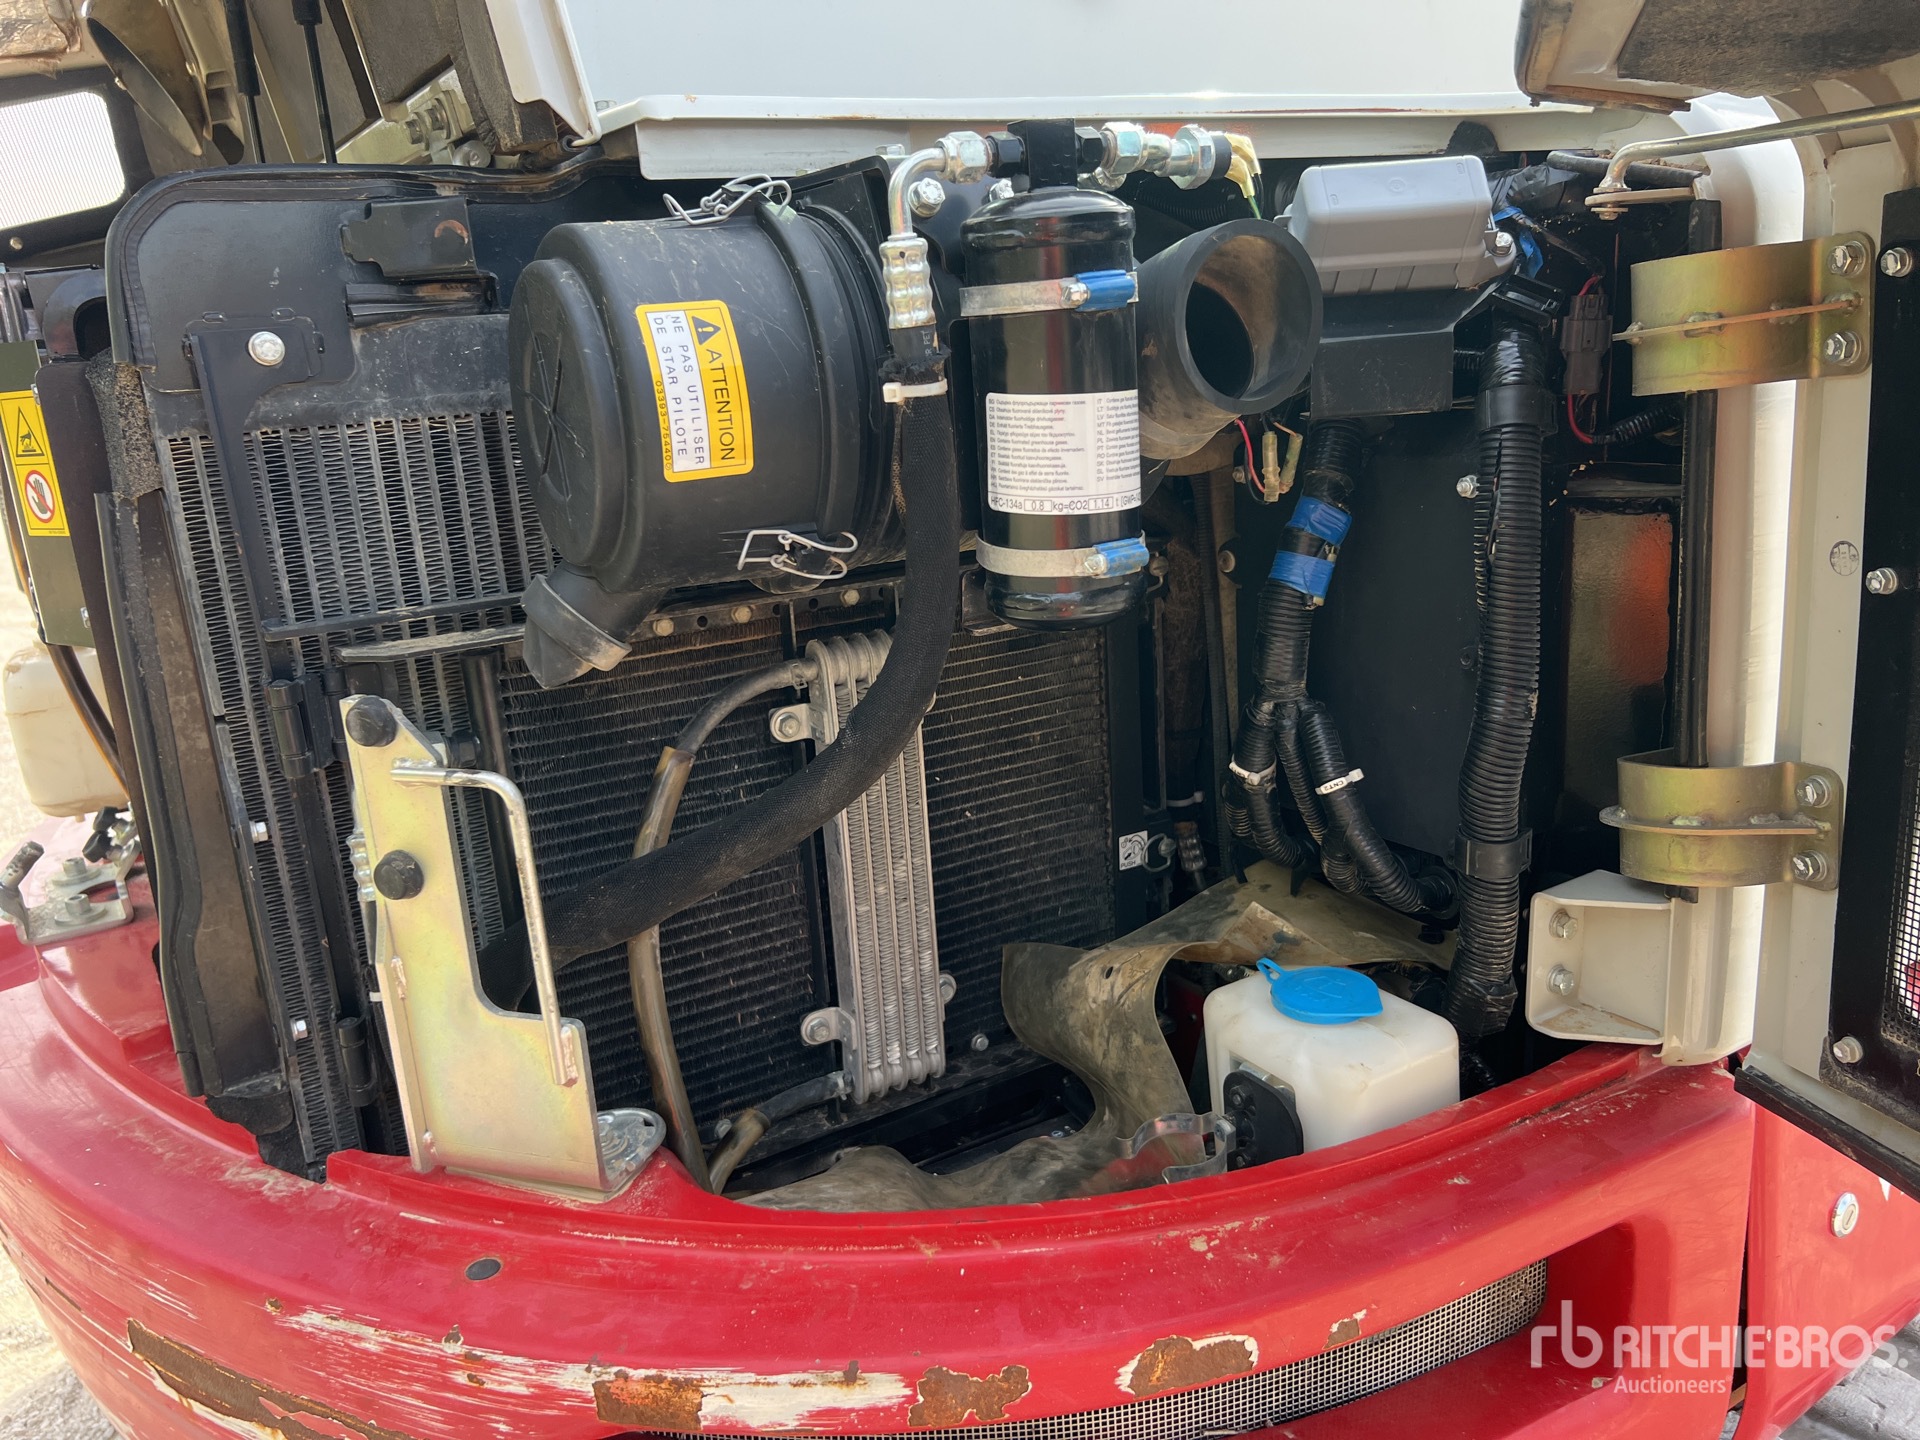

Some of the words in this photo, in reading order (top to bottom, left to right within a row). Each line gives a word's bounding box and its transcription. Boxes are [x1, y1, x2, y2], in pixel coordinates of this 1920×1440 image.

[653, 317, 667, 335] DE
[662, 346, 678, 385] STAR
[672, 397, 688, 457] PILOTE
[670, 316, 684, 334] NE
[678, 344, 693, 373] PAS
[687, 384, 705, 465] UTILISER
[706, 348, 735, 461] ATTENTION
[1031, 501, 1045, 511] 0.8
[1121, 860, 1136, 868] PUSH
